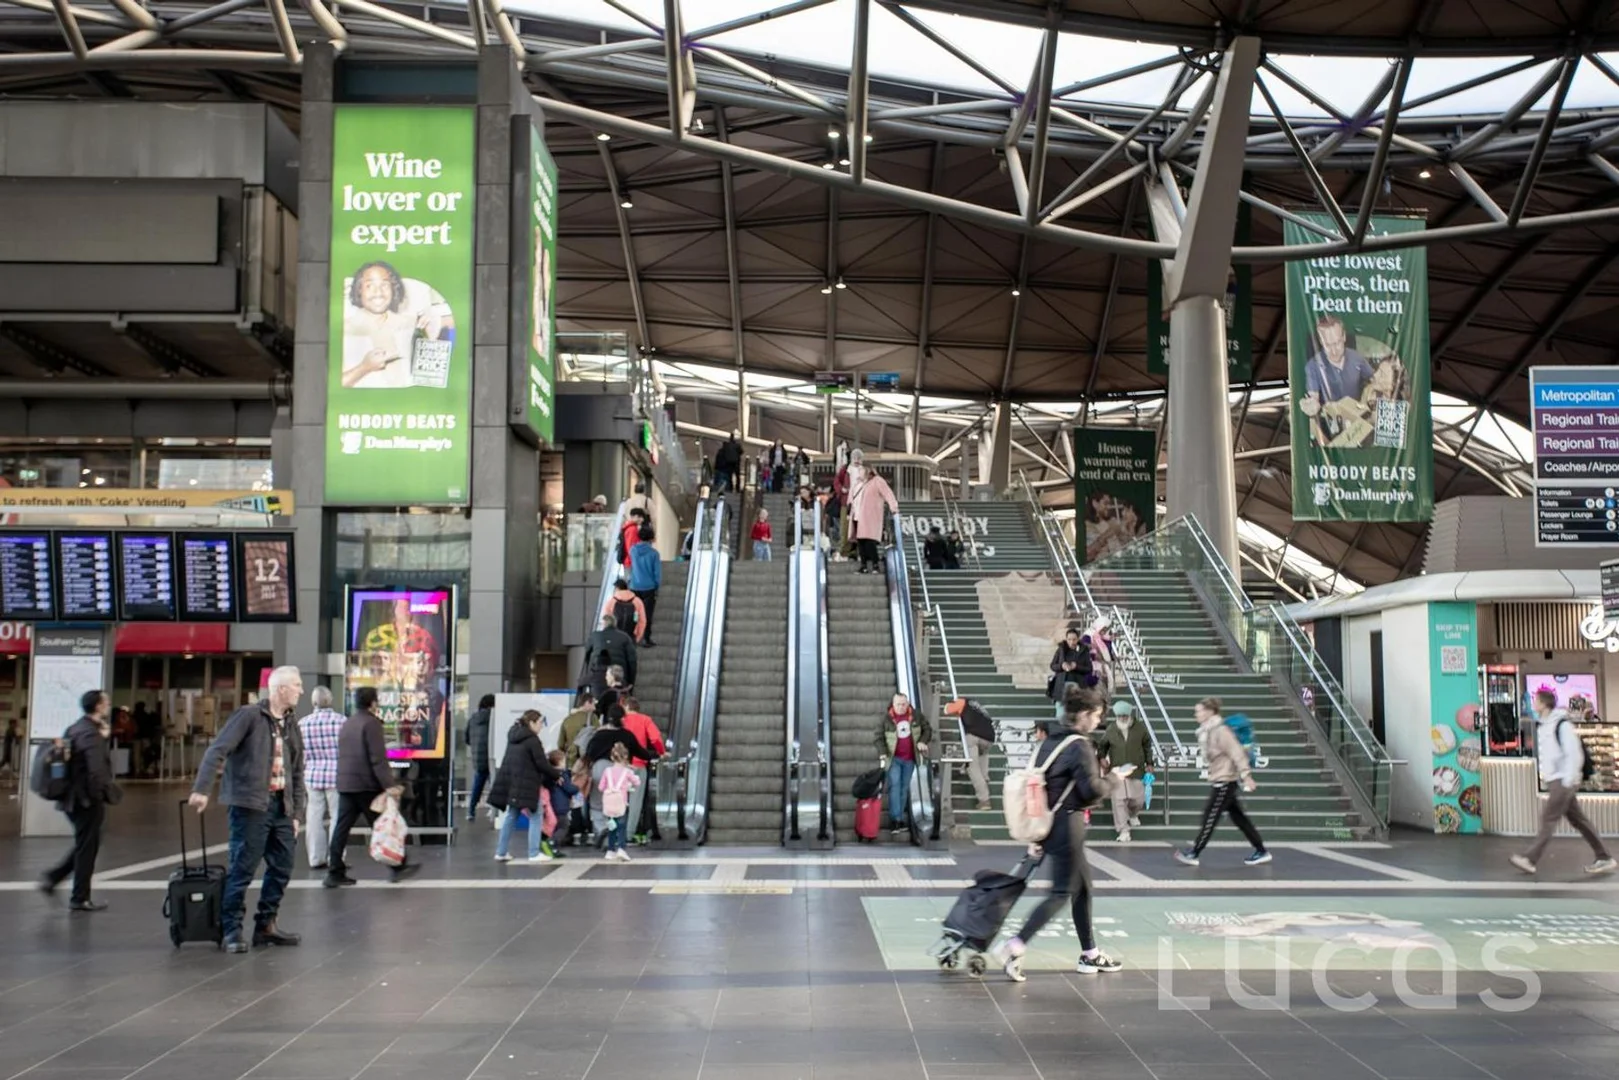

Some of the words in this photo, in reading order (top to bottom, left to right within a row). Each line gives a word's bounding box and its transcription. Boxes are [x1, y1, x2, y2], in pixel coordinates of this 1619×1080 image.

[364, 151, 442, 179] Wine
[342, 184, 422, 211] lover
[427, 191, 463, 211] or
[350, 221, 452, 252] expert
[1344, 254, 1402, 271] lowest
[1304, 271, 1365, 294] prices,
[1369, 273, 1410, 293] then
[1312, 293, 1353, 313] beat
[1356, 295, 1403, 314] them
[1541, 389, 1615, 404] Metropolitan
[338, 413, 403, 429] NOBODY
[406, 414, 456, 429] BEATS
[1542, 413, 1594, 428] Regional
[1097, 442, 1132, 454] House
[1543, 437, 1595, 452] Regional
[1083, 455, 1133, 470] warming
[1135, 458, 1148, 468] or
[1079, 469, 1101, 480] end
[1103, 469, 1115, 480] of
[1116, 472, 1130, 481] an
[1132, 472, 1151, 482] era
[1308, 464, 1368, 480] NOBODY
[1372, 465, 1416, 481] BEATS
[3, 497, 15, 506] to
[20, 496, 62, 506] refresh
[67, 496, 92, 506] with
[137, 497, 187, 509] Vending
[1540, 511, 1571, 519] Passenger
[1571, 511, 1594, 520] Lounge
[1541, 533, 1559, 541] Prayer
[254, 558, 281, 582] 12
[40, 637, 75, 647] Southern
[76, 637, 100, 647] Cross
[72, 646, 100, 655] Station
